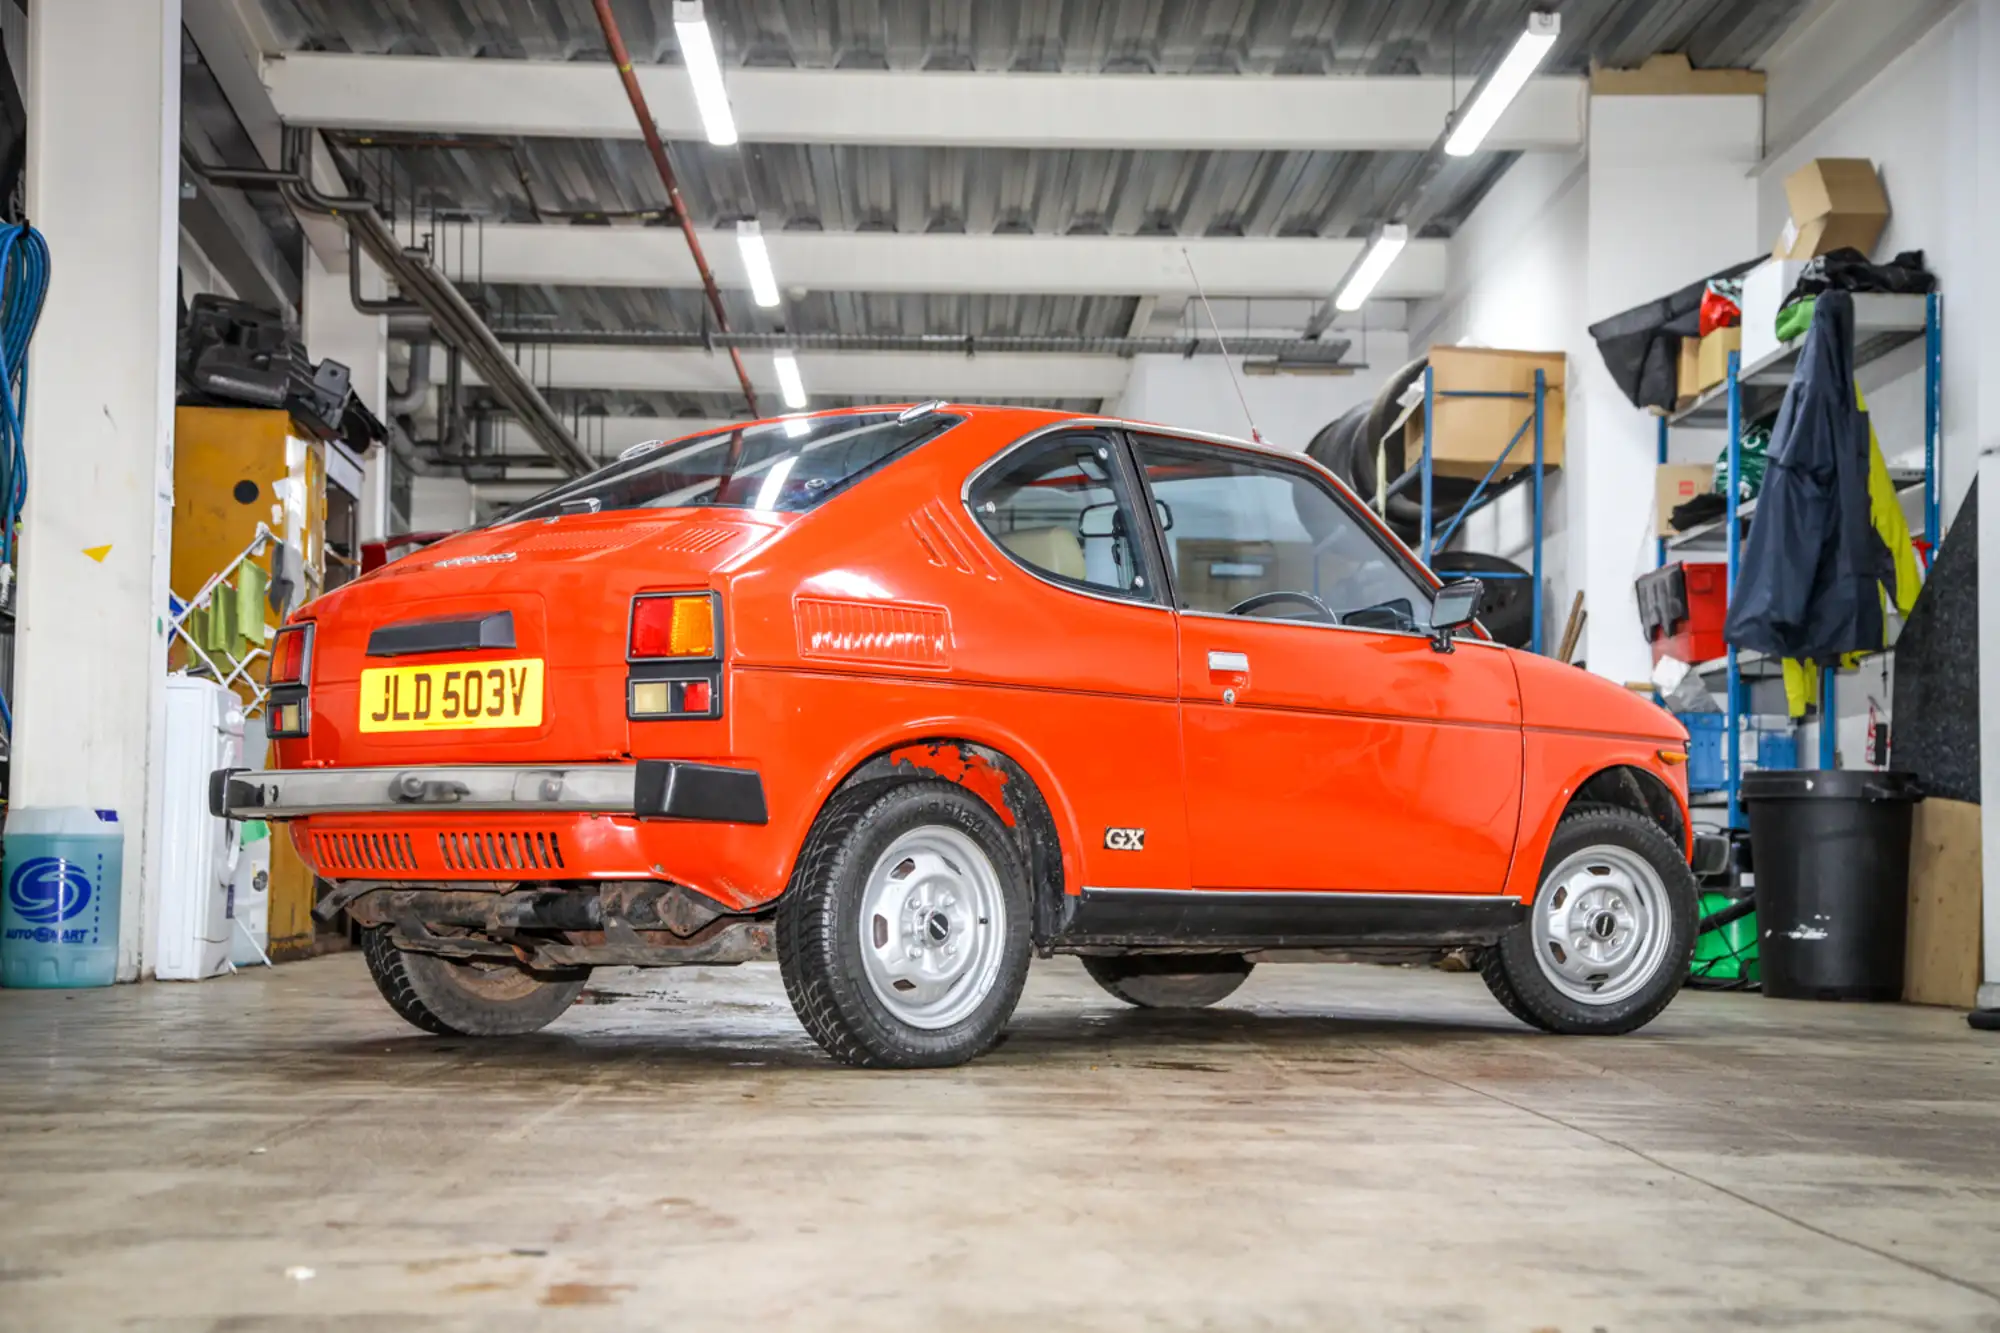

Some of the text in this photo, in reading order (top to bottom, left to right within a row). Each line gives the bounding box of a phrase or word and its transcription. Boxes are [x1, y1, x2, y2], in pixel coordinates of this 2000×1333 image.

[371, 667, 528, 722] JLD 503V
[1105, 828, 1145, 851] GX
